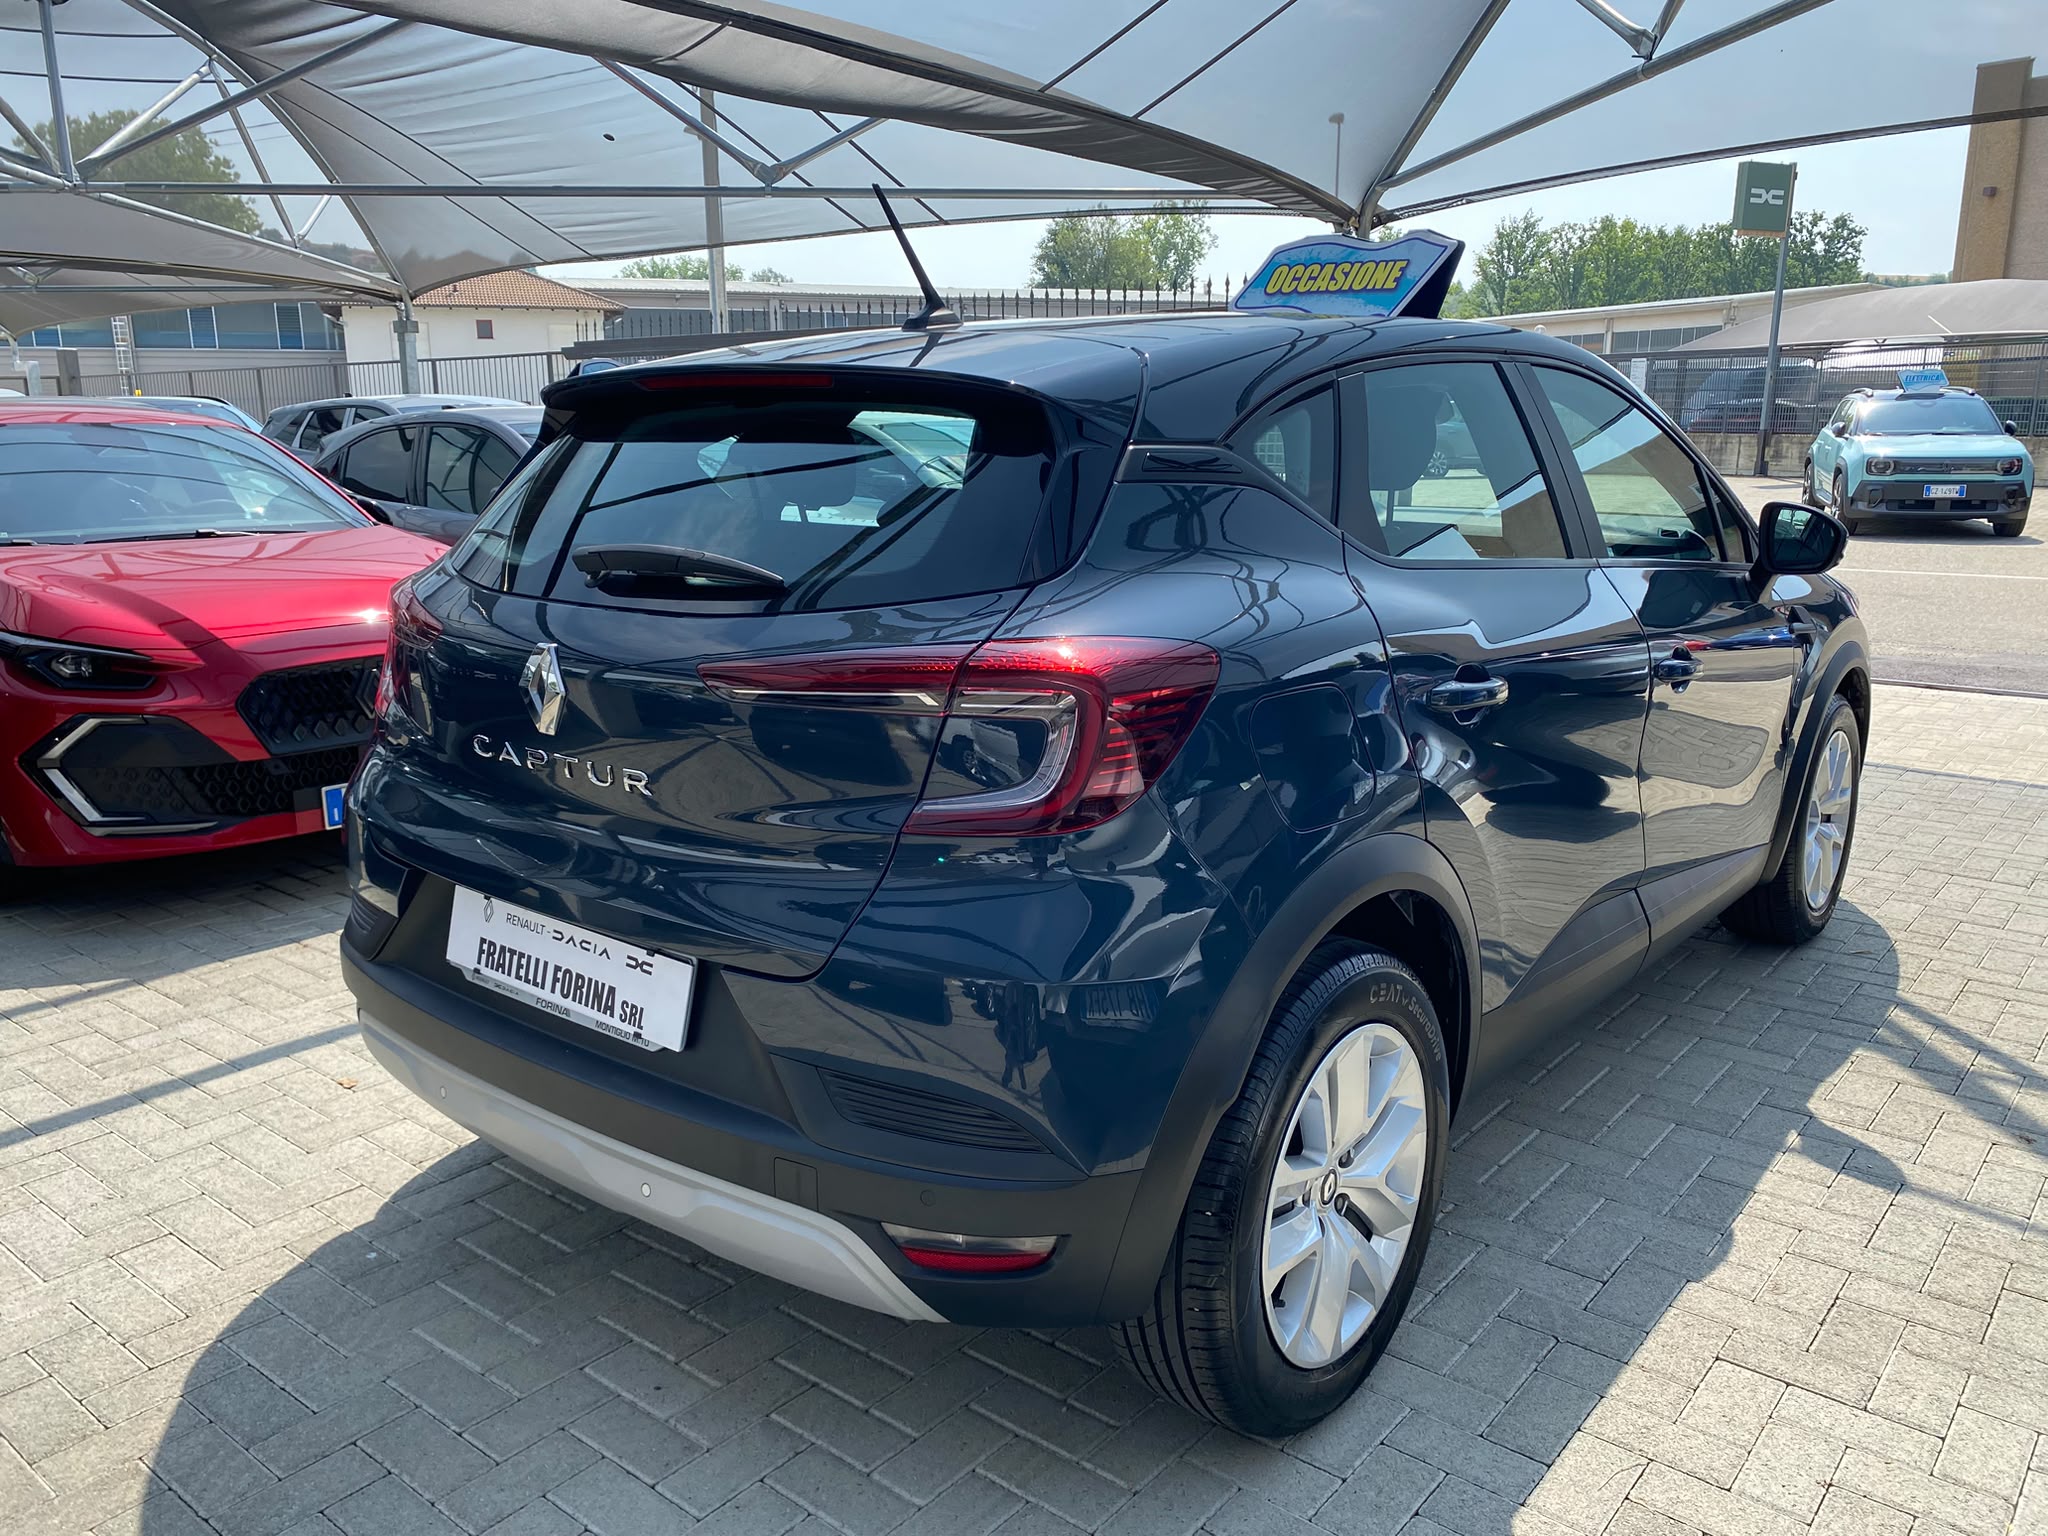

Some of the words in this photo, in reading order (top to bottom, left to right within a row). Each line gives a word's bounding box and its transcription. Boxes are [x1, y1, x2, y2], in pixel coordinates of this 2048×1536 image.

[1264, 258, 1410, 296] OCCASIONE
[1904, 374, 1940, 382] ELETTRICA
[472, 734, 653, 797] CAPTUR
[506, 913, 546, 936] RENAULT
[552, 929, 611, 961] DACIA
[476, 936, 548, 991] FRATELLI
[550, 964, 617, 1018] FORINA
[619, 999, 645, 1031] SRL
[1370, 983, 1402, 1004] CEAT
[535, 997, 568, 1017] FORINA
[595, 1020, 631, 1040] MONTIGLIO
